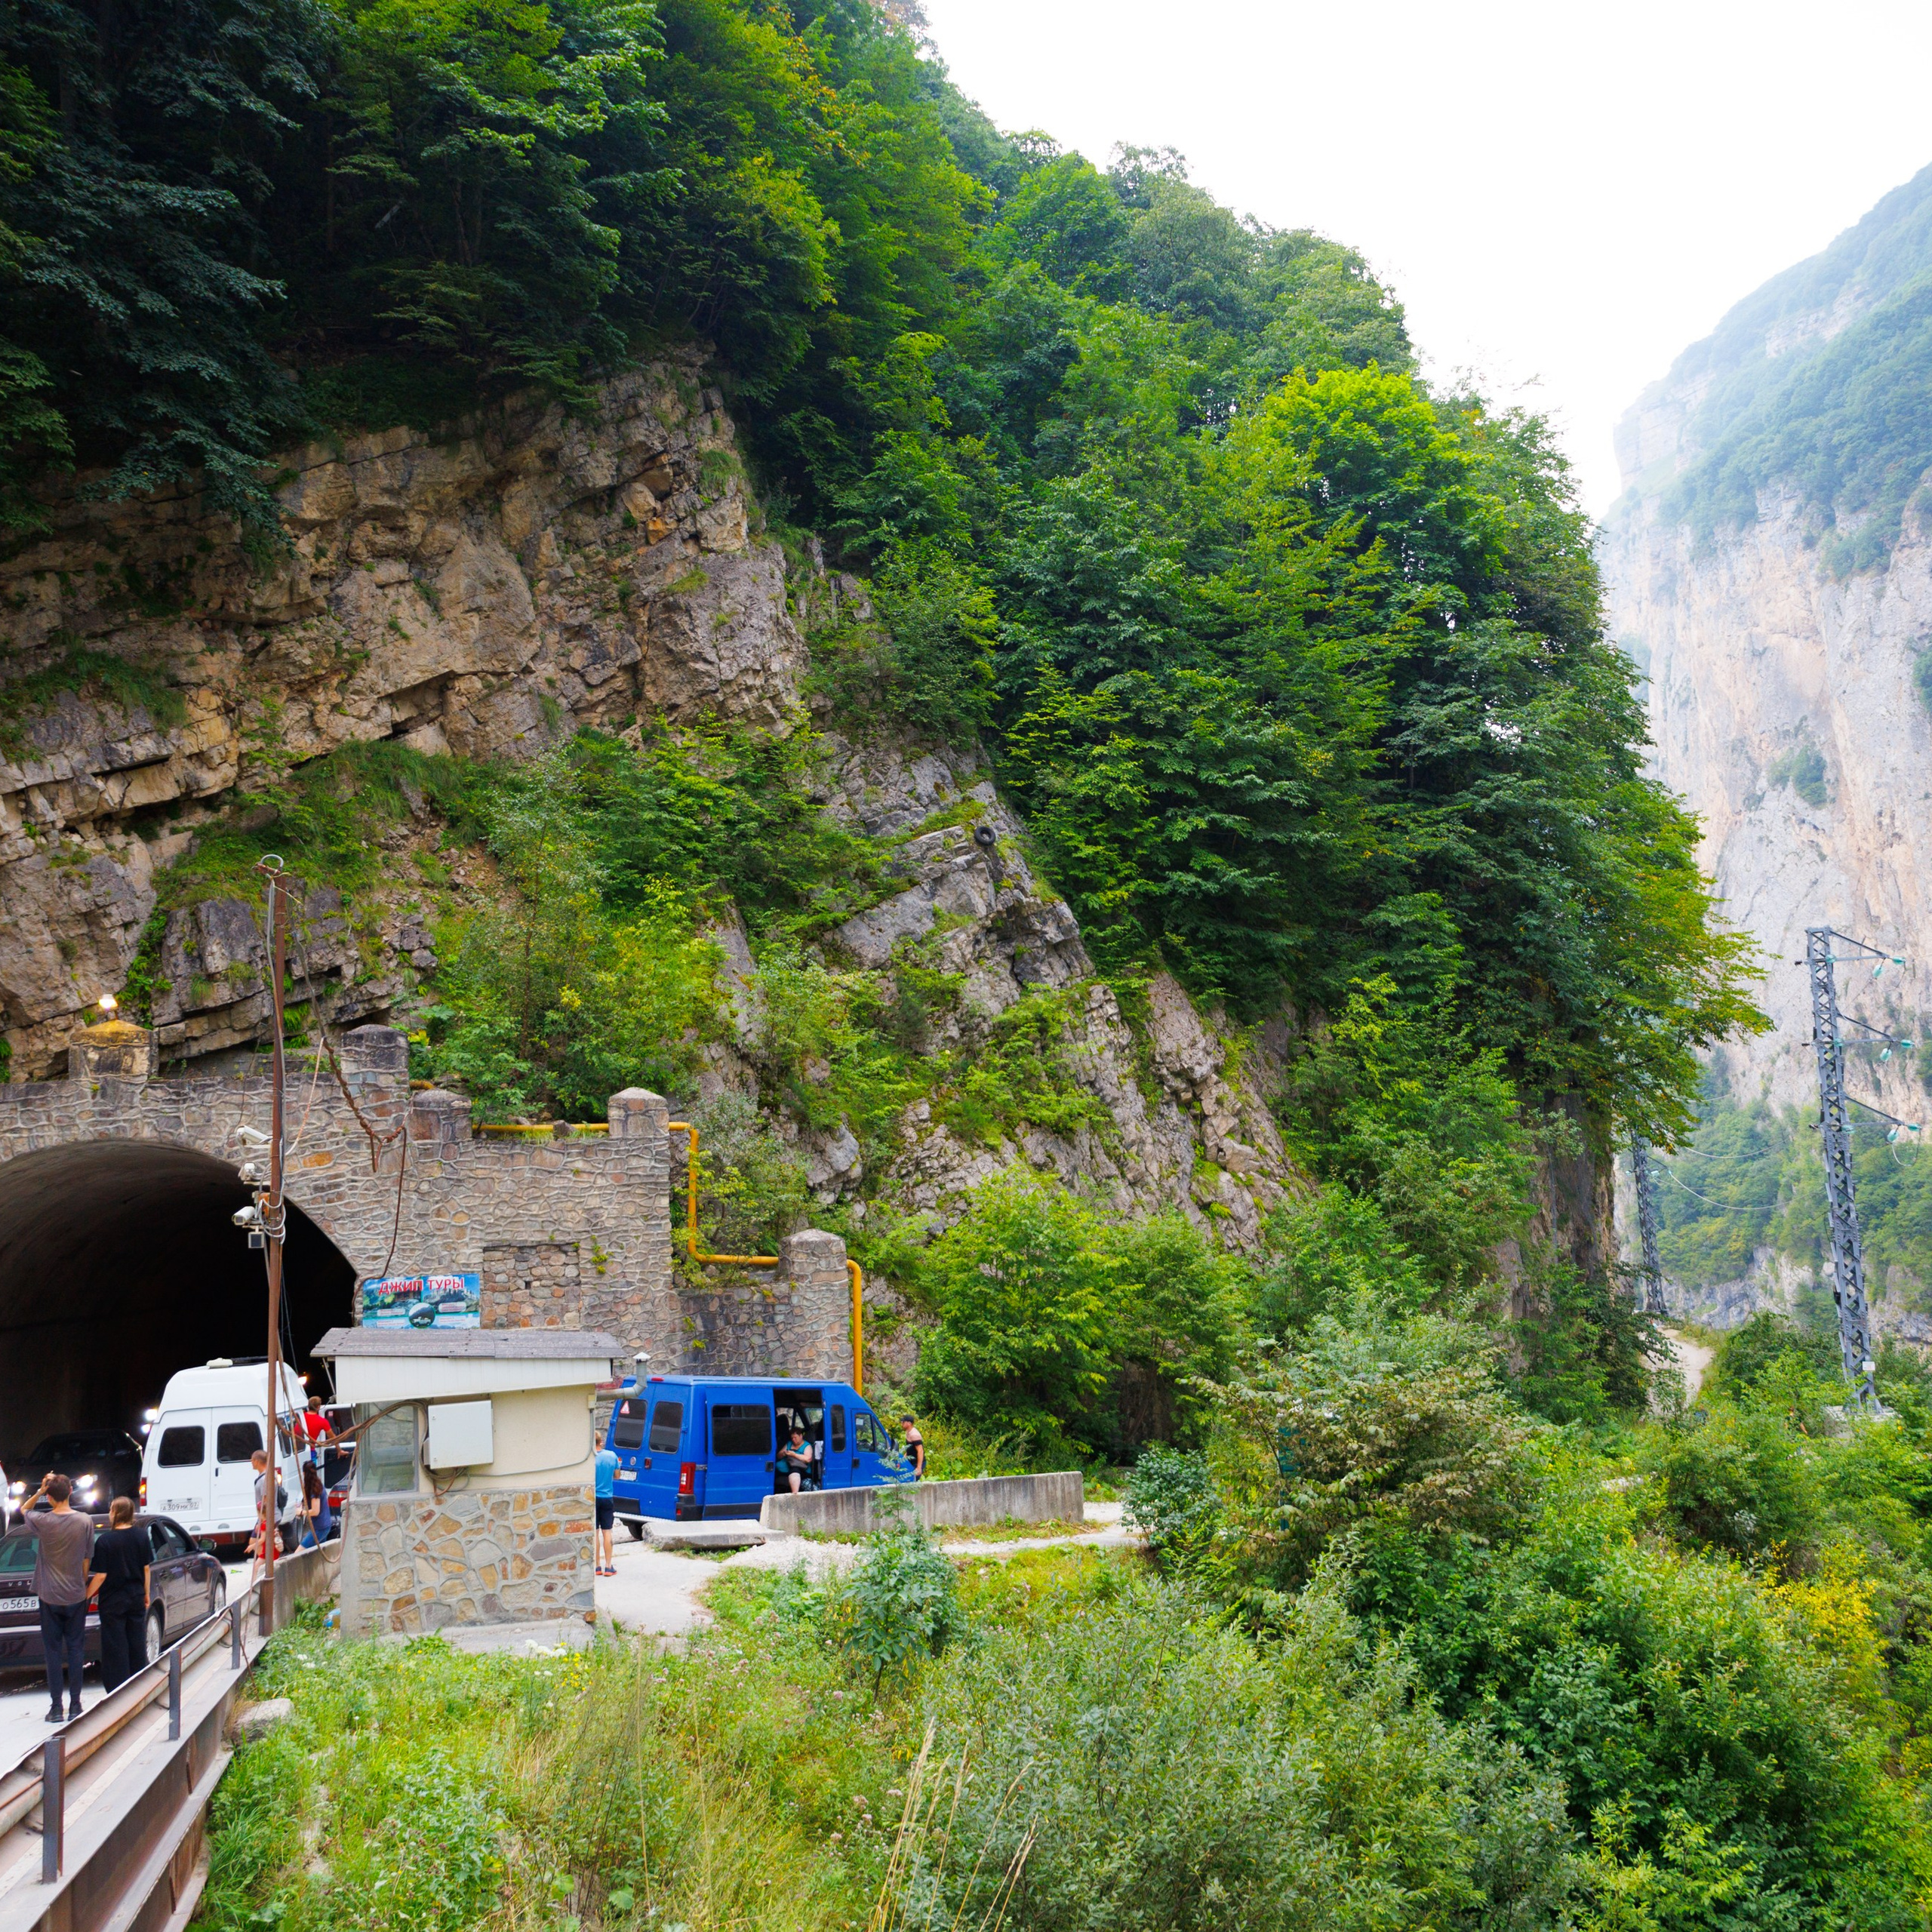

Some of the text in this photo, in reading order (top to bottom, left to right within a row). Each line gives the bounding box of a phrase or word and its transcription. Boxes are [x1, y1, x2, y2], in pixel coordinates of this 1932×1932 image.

[379, 1278, 463, 1296] ДЖИП ТУРЫ
[2, 1598, 36, 1609] О565В
